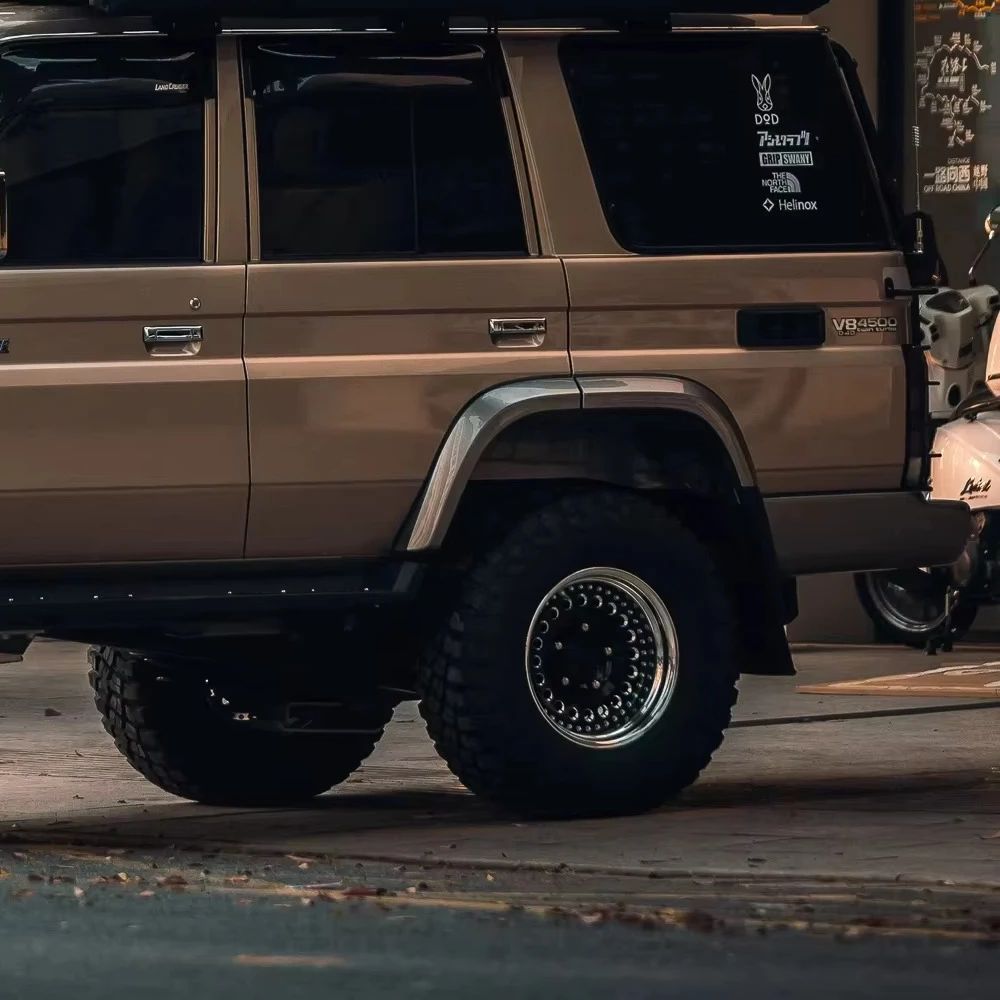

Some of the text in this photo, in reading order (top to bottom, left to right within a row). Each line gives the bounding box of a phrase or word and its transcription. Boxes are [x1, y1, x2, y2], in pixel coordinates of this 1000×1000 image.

[761, 153, 810, 165] GRIP SWANY
[771, 171, 786, 179] THE
[761, 179, 787, 187] NORTH
[778, 198, 818, 211] Helinox
[831, 317, 898, 331] V8 4500
